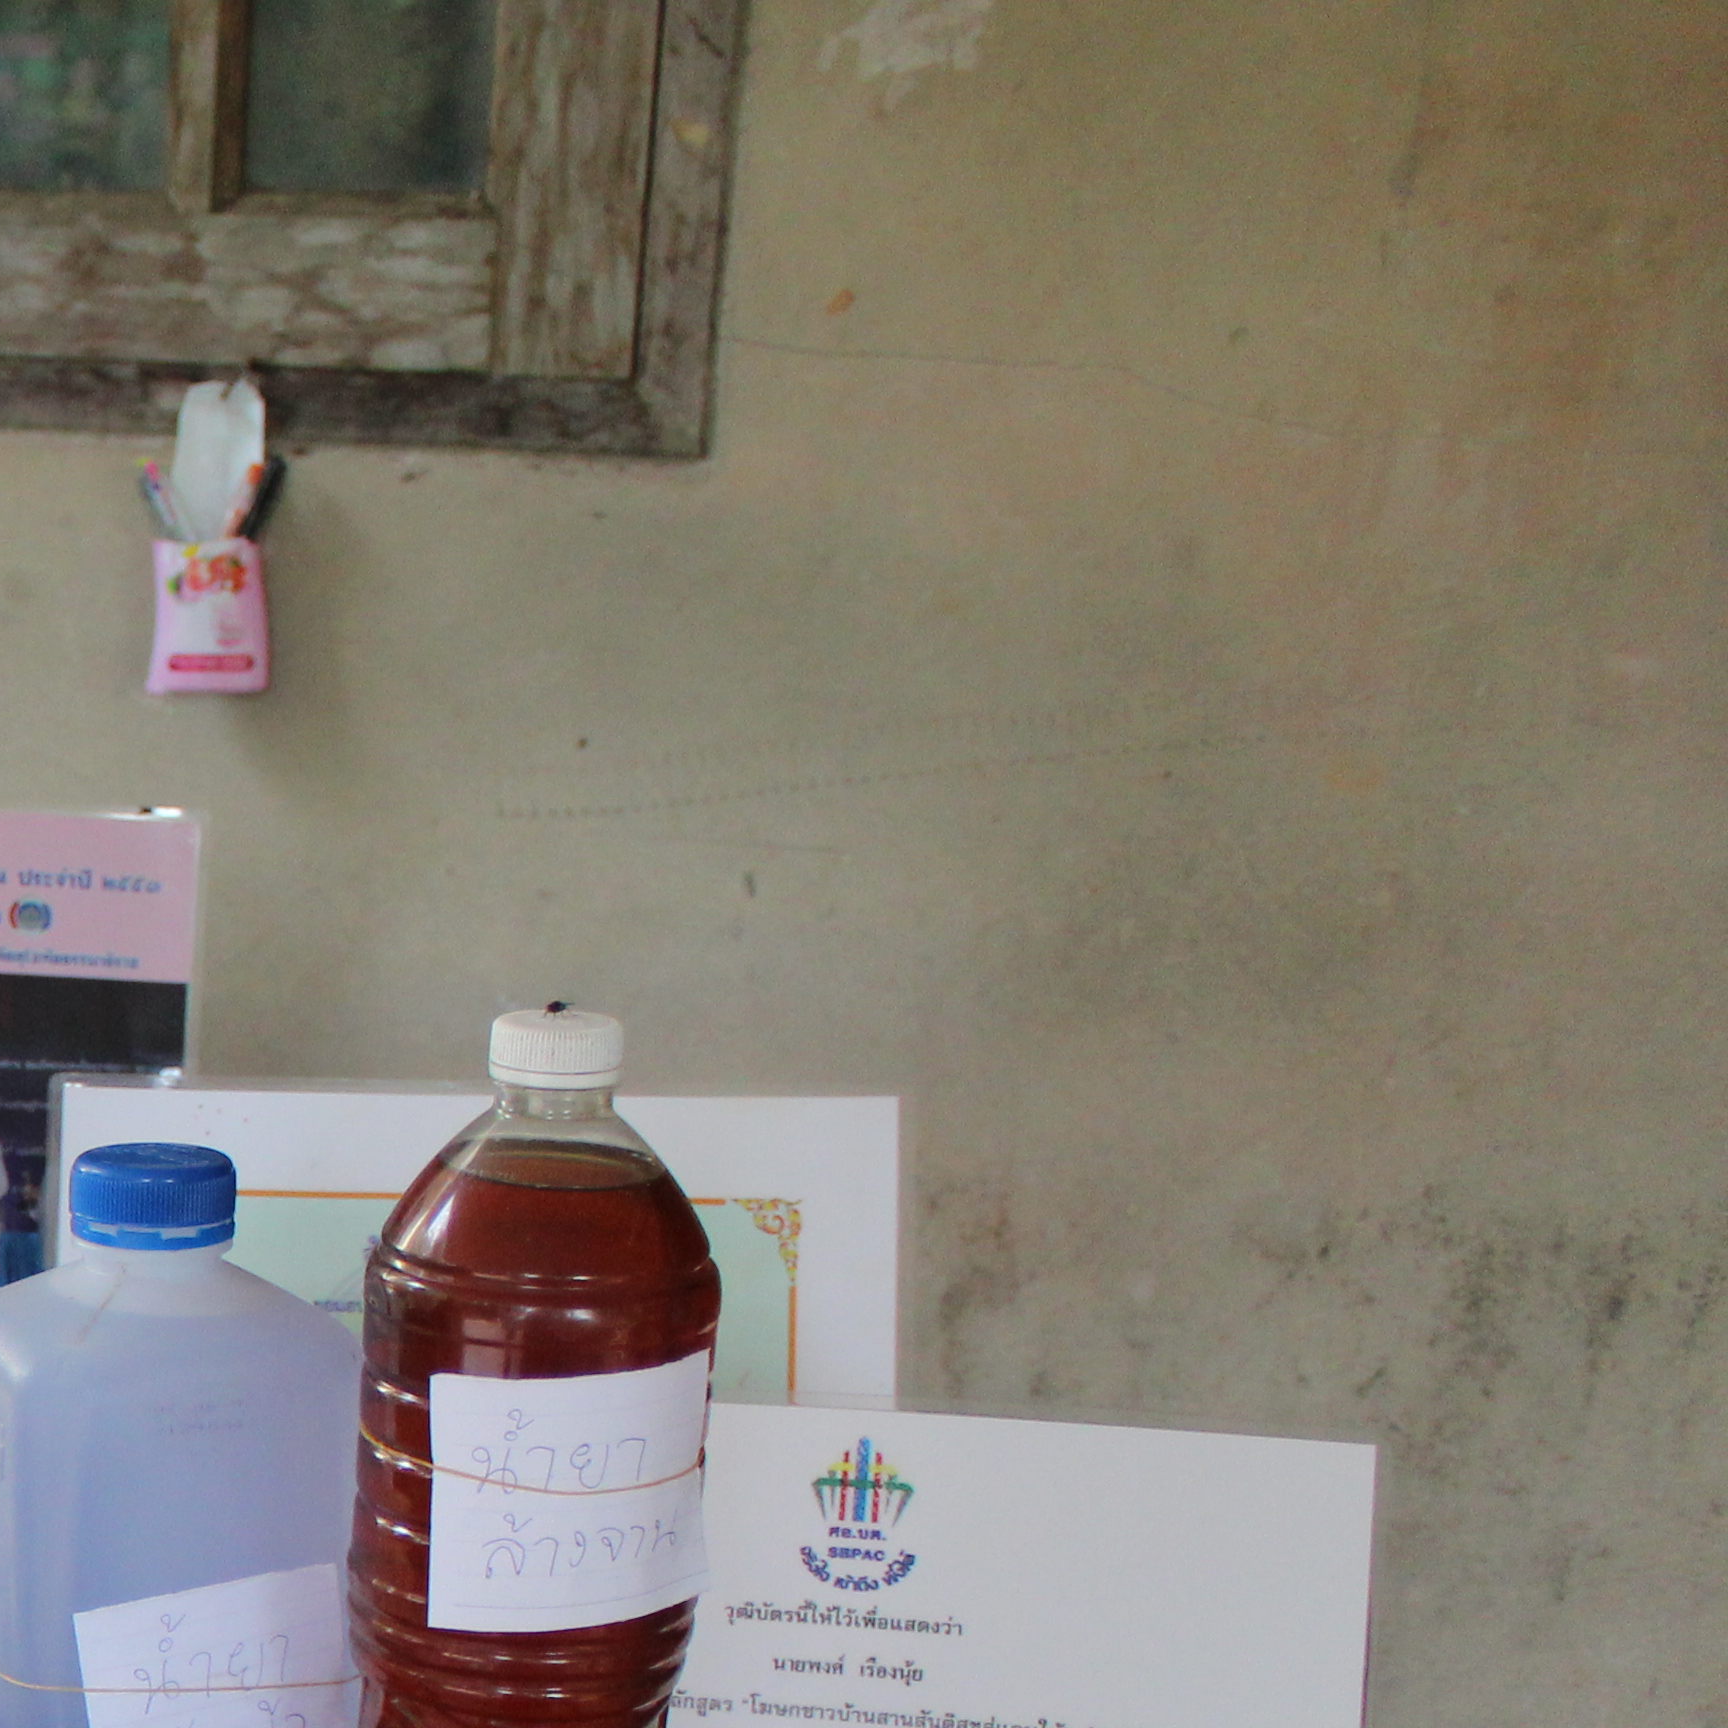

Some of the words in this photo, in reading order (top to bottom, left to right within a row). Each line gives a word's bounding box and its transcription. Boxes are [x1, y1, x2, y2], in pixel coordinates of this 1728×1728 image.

[471, 1408, 646, 1495] น้ำยา
[482, 1508, 677, 1579] ล้างจาน
[725, 1601, 963, 1637] วุฒิบัตรนี้ให้ไว้เพื่อแสดงว่า
[133, 1613, 289, 1715] น้ำยา
[773, 1654, 845, 1676] นายพงศ์
[859, 1656, 923, 1687] เรืองนุ้ย
[669, 1689, 733, 1717] ลักสูตร
